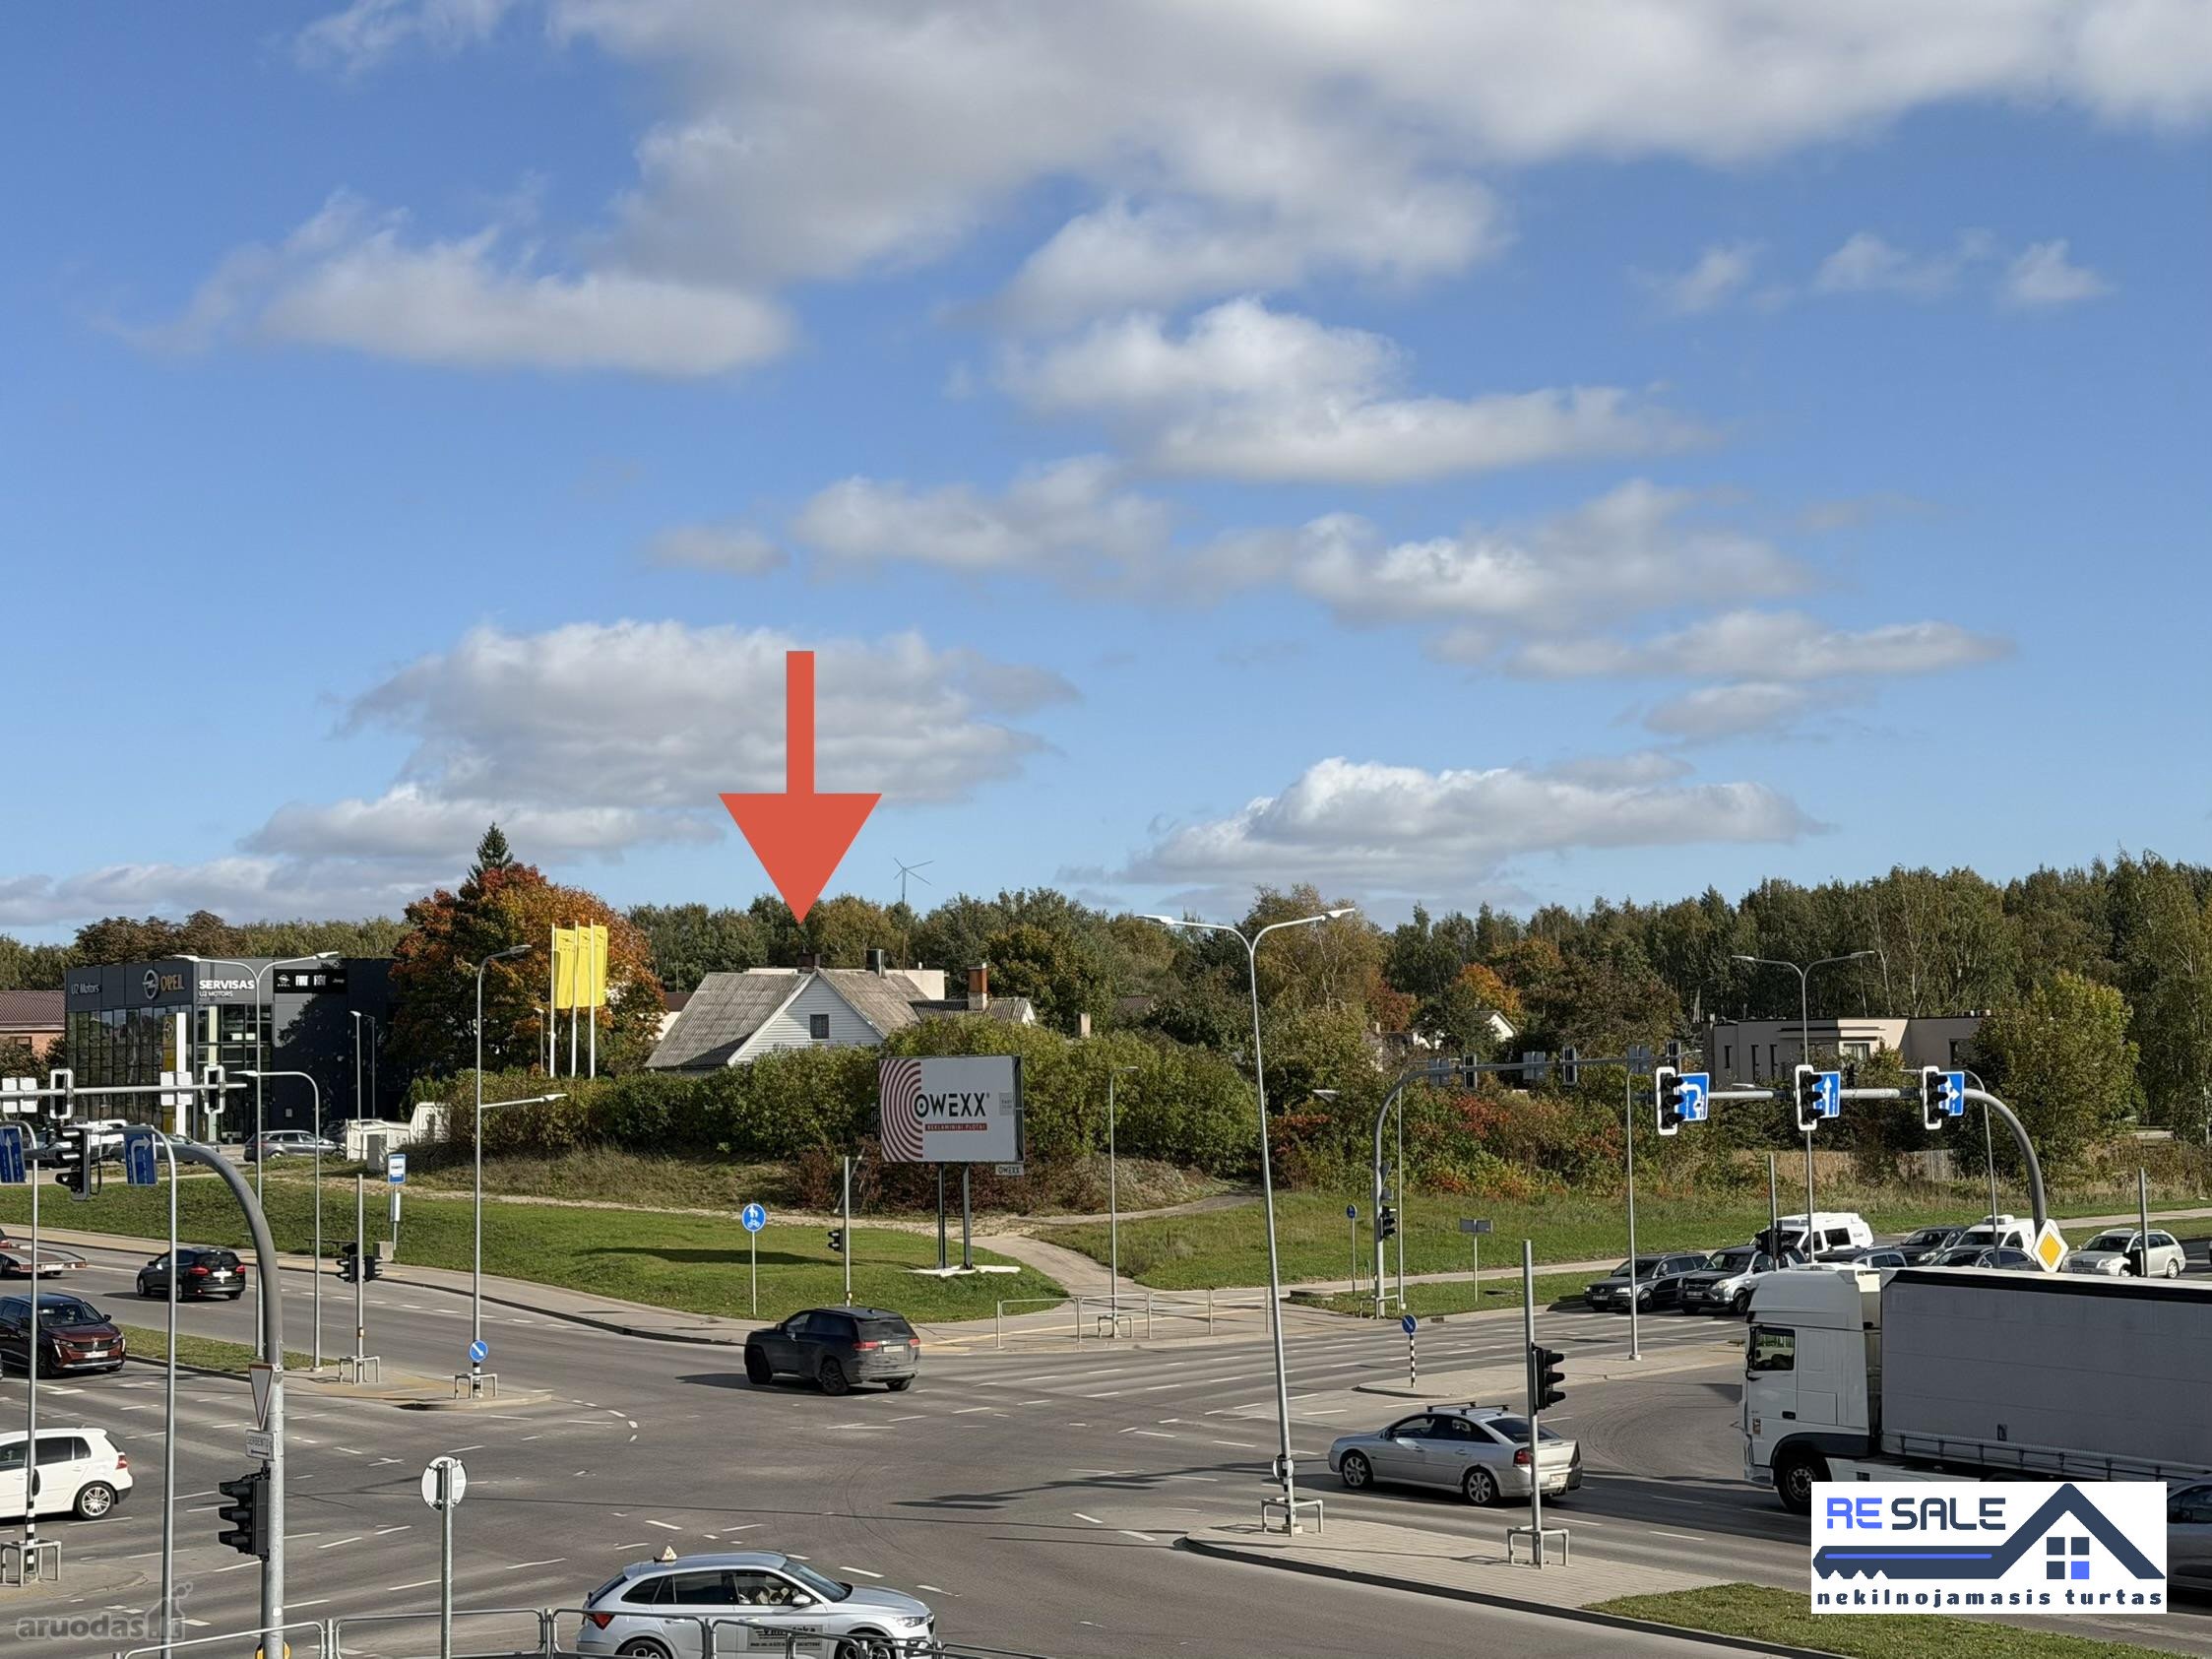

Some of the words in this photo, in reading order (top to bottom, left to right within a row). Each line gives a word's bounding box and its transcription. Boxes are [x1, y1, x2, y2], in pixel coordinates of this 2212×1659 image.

[159, 974, 185, 991] OPEL
[199, 980, 255, 989] SERVISAS
[80, 983, 100, 994] Motors
[914, 1093, 986, 1118] OWEXX
[998, 1166, 1020, 1175] OWEXX
